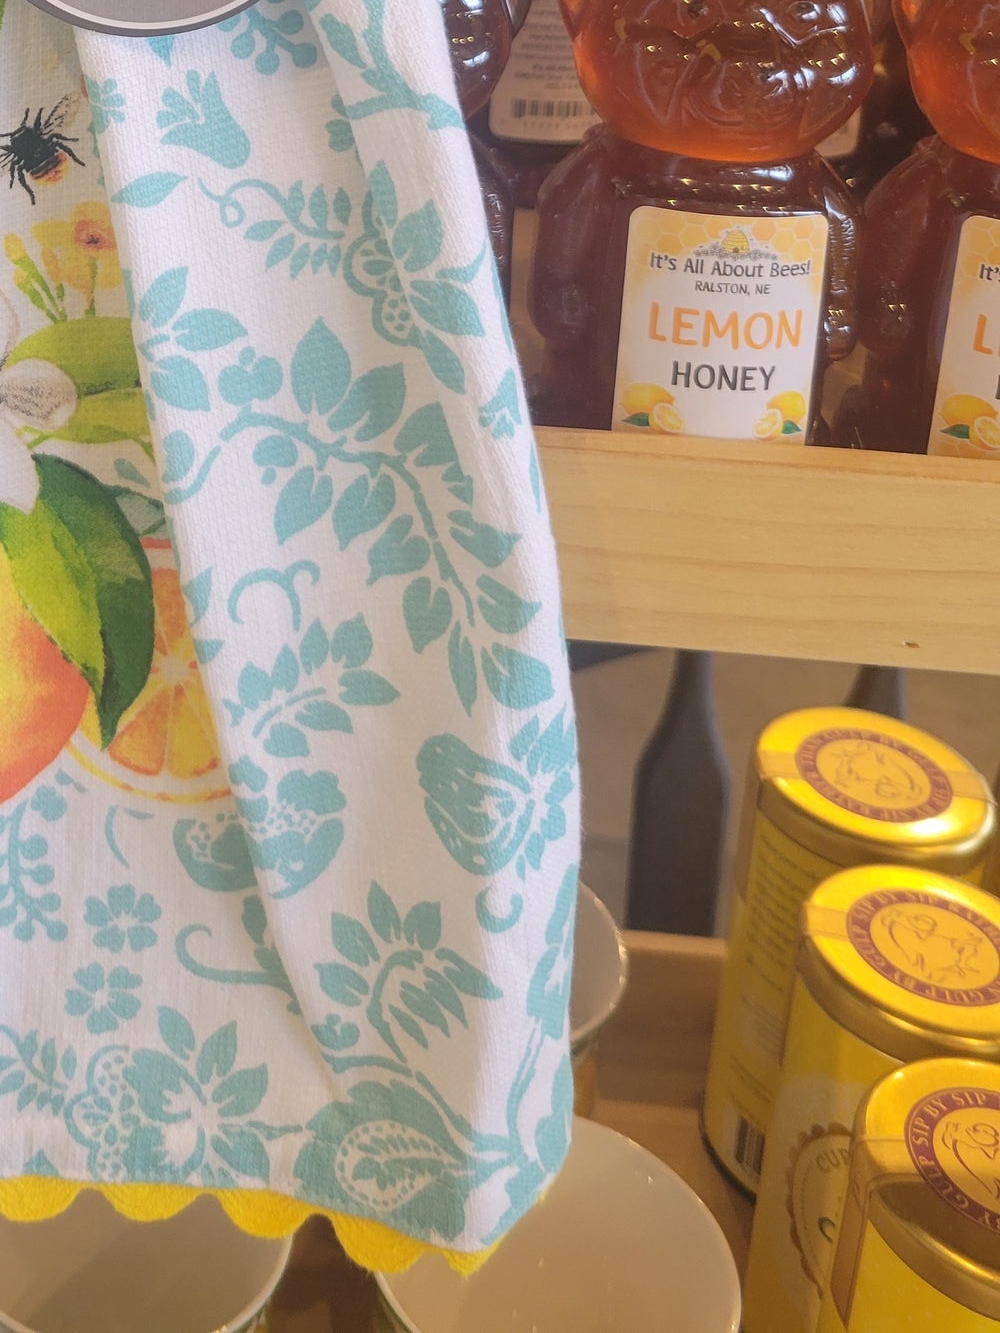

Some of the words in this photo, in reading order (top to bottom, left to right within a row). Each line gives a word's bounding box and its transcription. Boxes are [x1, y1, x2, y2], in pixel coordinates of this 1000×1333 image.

[650, 252, 677, 271] It's
[683, 257, 704, 275] All
[711, 260, 764, 278] About
[769, 260, 812, 278] Bees!
[979, 263, 1000, 282] It'
[694, 280, 751, 296] RALSTON,
[755, 283, 772, 295] NE
[648, 301, 804, 351] LEMON
[671, 360, 776, 392] HONEY
[912, 1117, 930, 1147] SIP
[923, 1097, 948, 1118] BY
[951, 1091, 986, 1106] SIP
